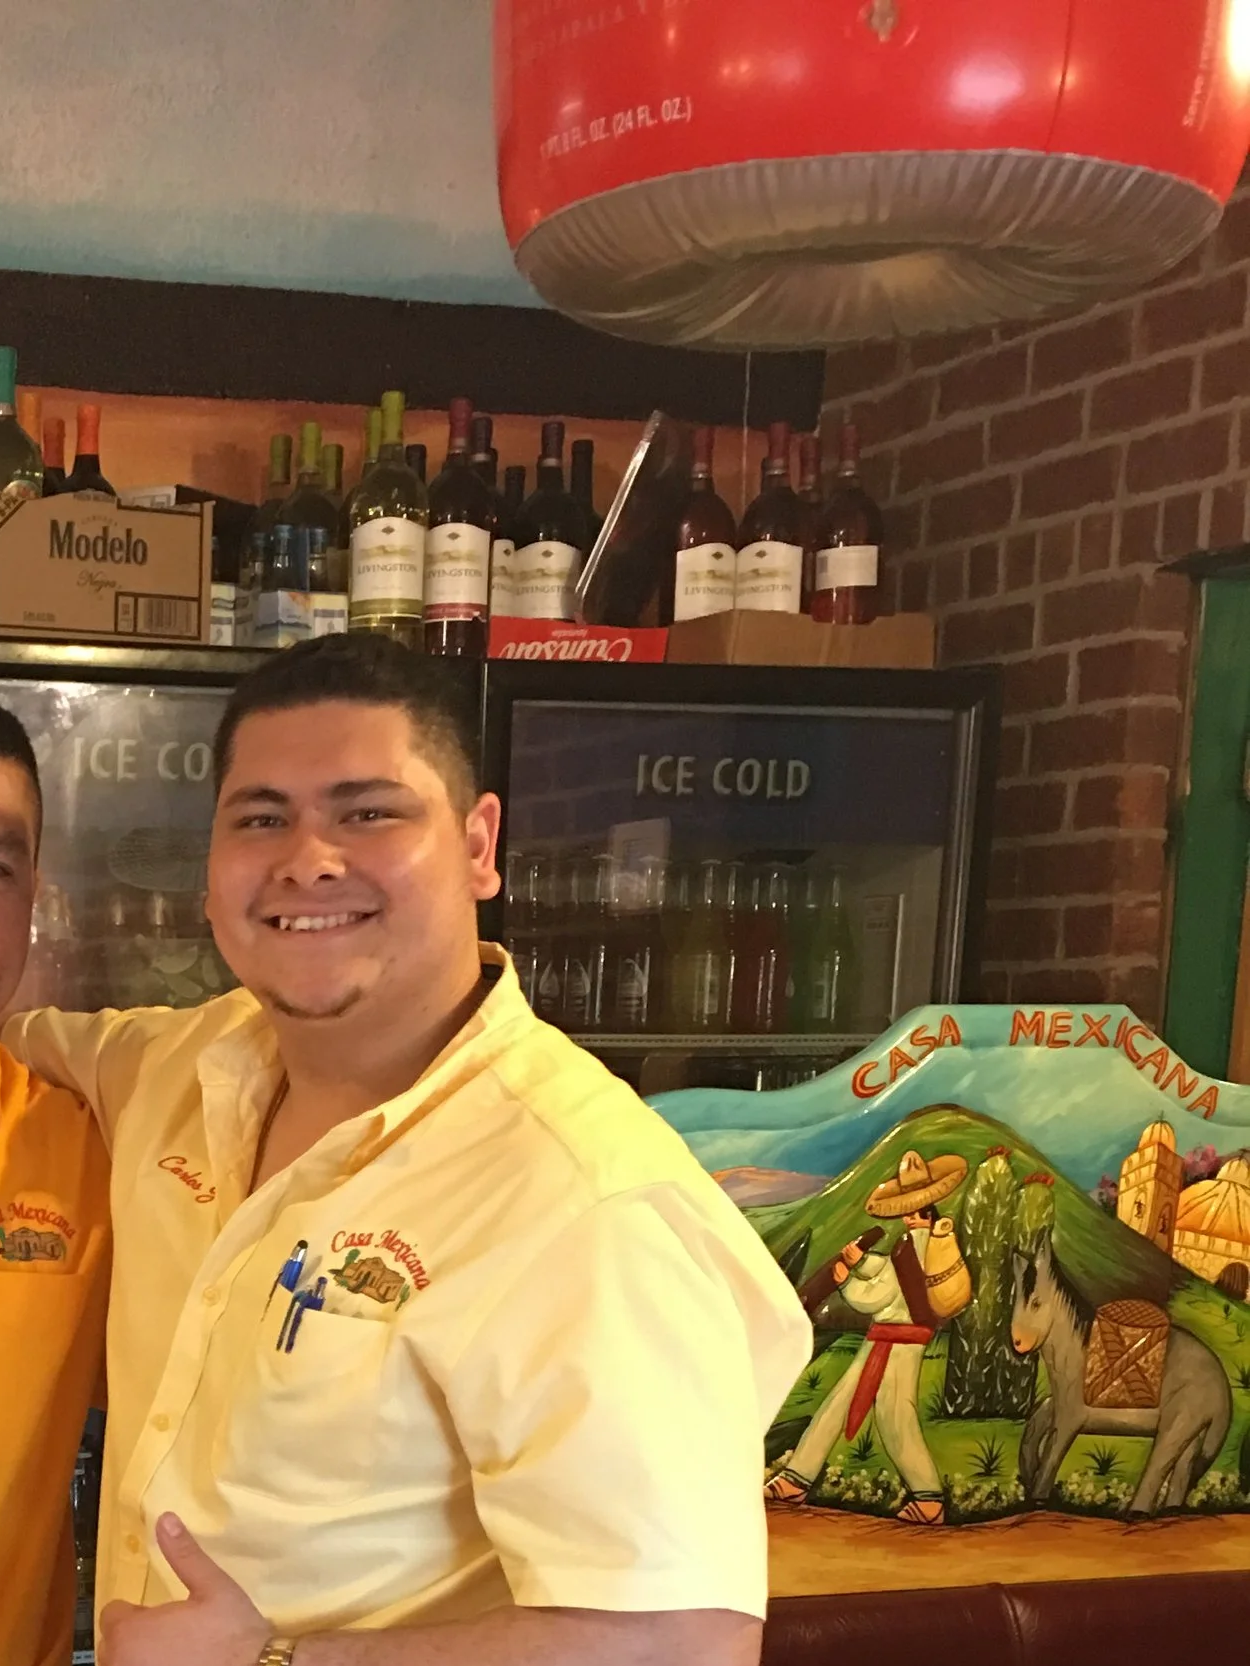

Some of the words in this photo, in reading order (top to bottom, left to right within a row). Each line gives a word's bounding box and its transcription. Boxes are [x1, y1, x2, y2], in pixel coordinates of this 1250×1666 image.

[590, 116, 611, 143] OZ.
[612, 108, 634, 139] (24
[637, 104, 659, 128] FL.
[661, 96, 692, 123] OZ.)
[49, 519, 148, 566] Modelo
[356, 563, 419, 575] LIVINGSTON
[73, 737, 138, 782] ICE
[157, 741, 214, 782] CO
[635, 754, 696, 796] ICE
[712, 757, 811, 799] COLD
[852, 1014, 962, 1099] CASA
[1009, 1010, 1220, 1120] MEXICANA
[157, 1156, 203, 1191] Carlos
[8, 1201, 77, 1239] Mexicana
[331, 1230, 374, 1253] Casa
[374, 1229, 431, 1291] Mexicana
